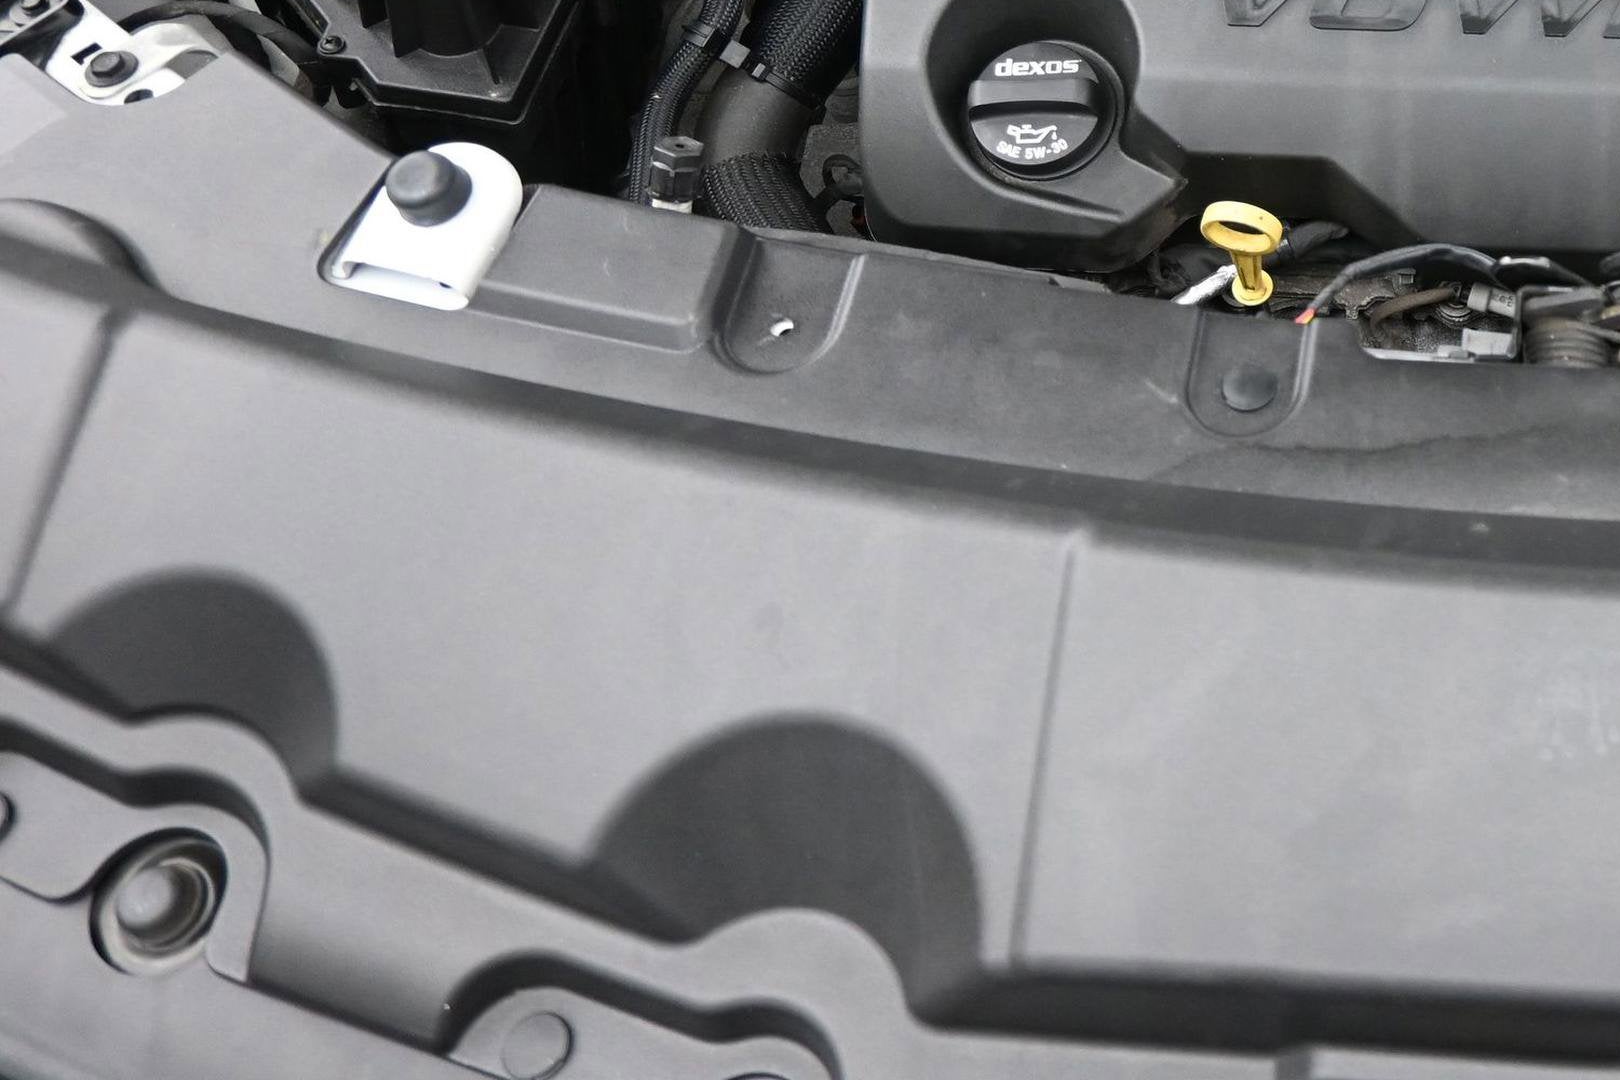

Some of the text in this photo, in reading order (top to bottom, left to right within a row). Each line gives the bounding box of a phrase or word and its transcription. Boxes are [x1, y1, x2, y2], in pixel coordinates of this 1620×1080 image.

[995, 58, 1081, 76] dexos
[996, 138, 1068, 160] SAE 5W-30
